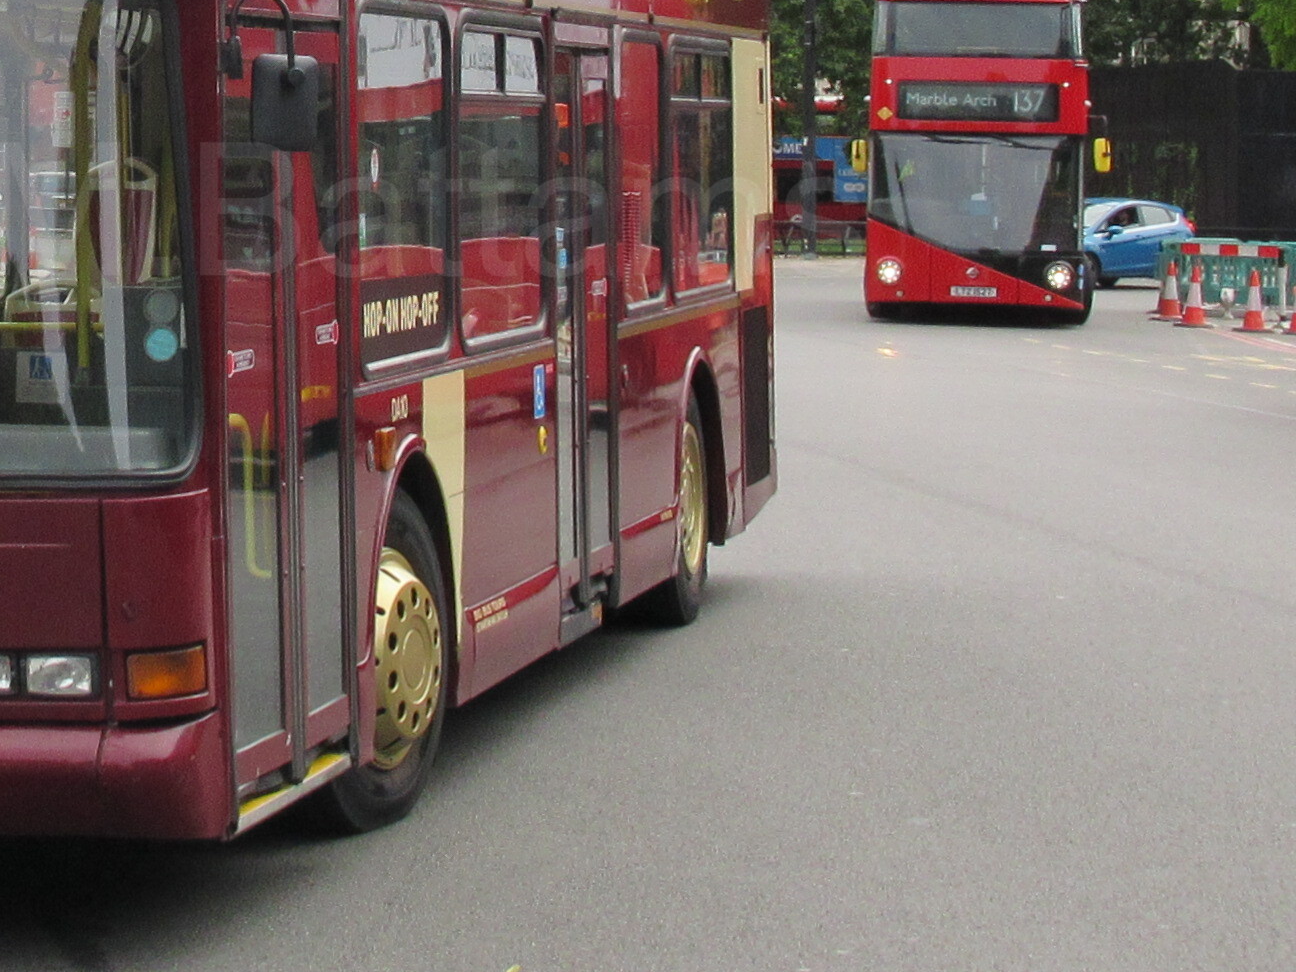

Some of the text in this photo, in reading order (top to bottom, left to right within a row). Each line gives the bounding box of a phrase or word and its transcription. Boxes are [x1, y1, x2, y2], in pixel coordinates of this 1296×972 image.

[906, 92, 997, 107] Marble Arch
[1013, 89, 1046, 113] 137
[363, 291, 439, 339] HOP-ON HOP-OFF
